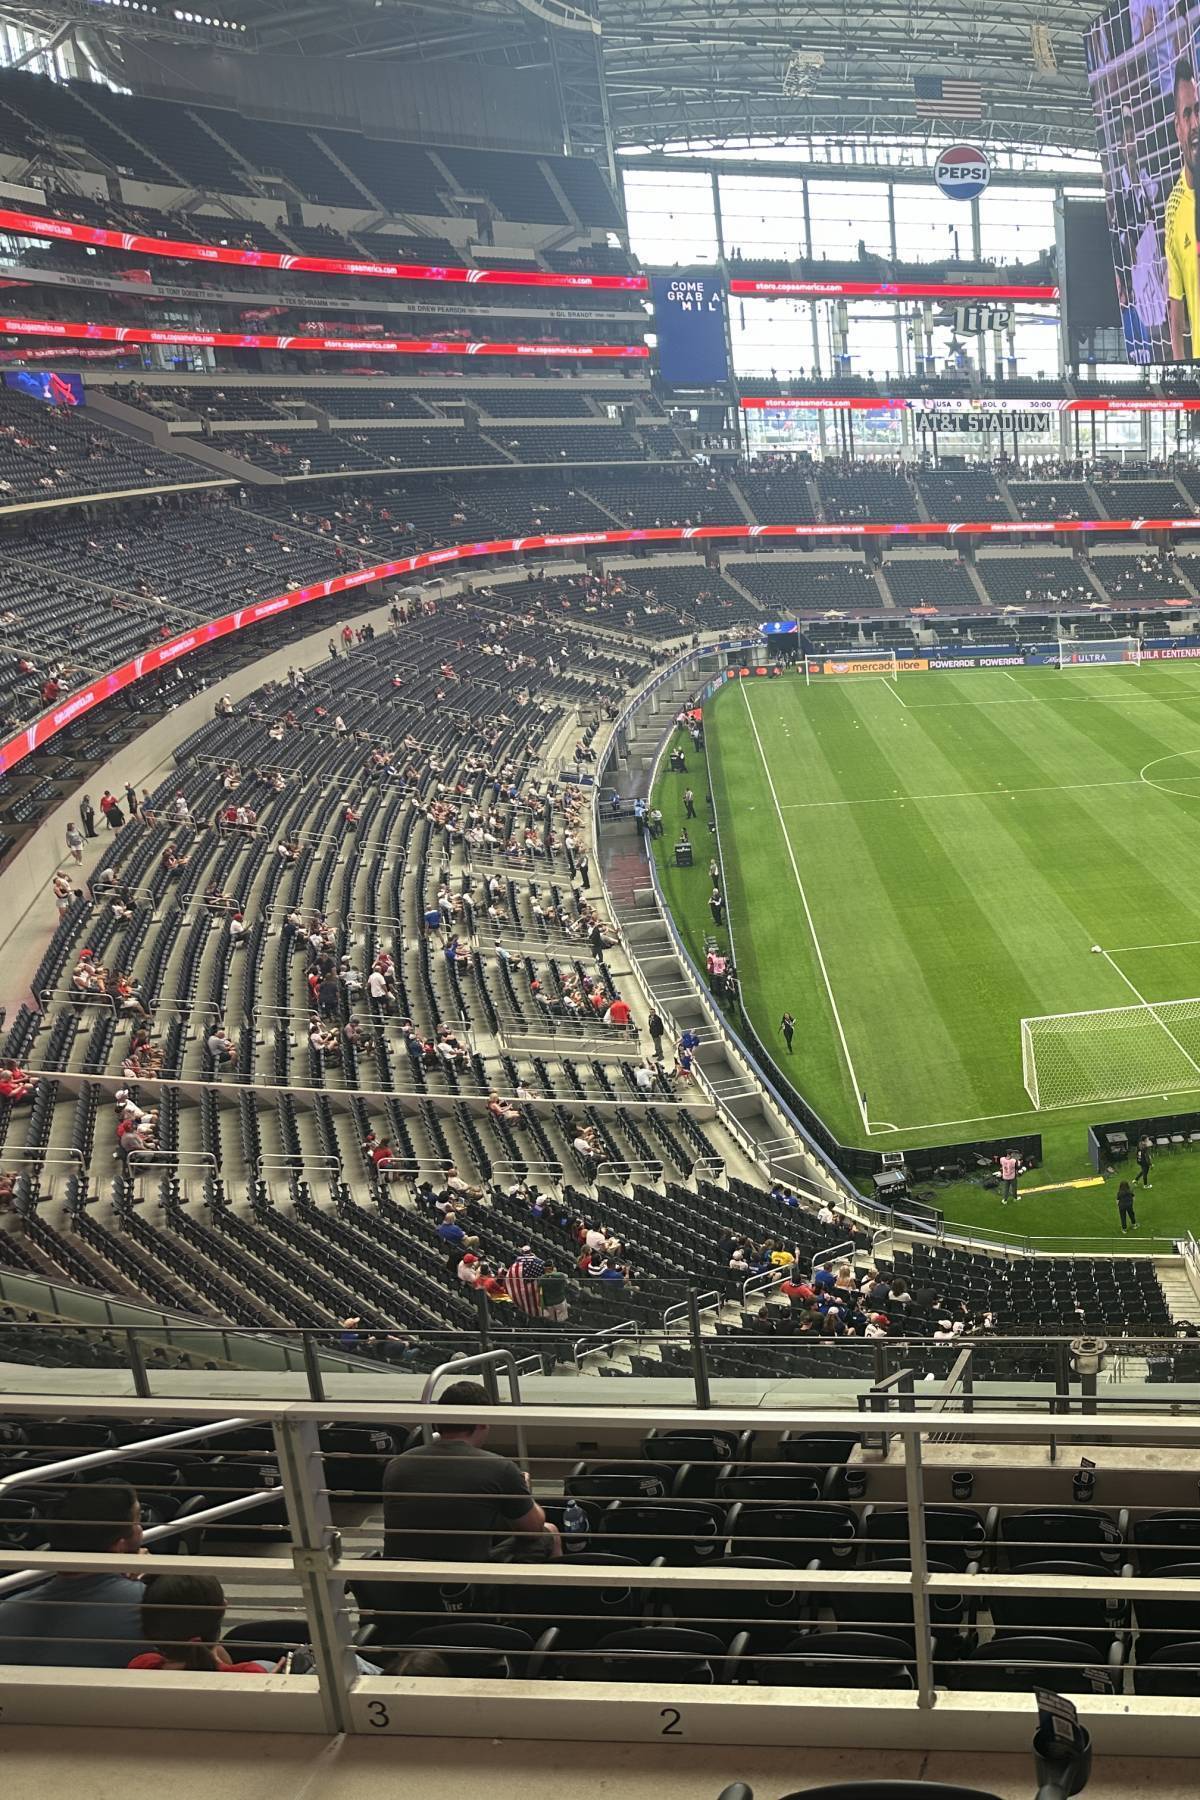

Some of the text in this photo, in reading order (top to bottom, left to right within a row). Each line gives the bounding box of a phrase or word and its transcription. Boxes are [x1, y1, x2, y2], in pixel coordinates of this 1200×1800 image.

[938, 167, 987, 180] PEPSI
[671, 282, 704, 292] COME
[756, 282, 842, 292] store.copaamerica.com
[667, 292, 720, 301] GRAB A
[418, 305, 436, 313] DREW
[437, 306, 466, 314] PEARSON
[953, 306, 1011, 337] Lite
[765, 399, 851, 408] store.copaamerica.com
[917, 413, 1049, 432] AT&T STADIUM
[1078, 653, 1107, 662] ULTRA
[1128, 650, 1160, 660] TEQUILA
[897, 660, 920, 670] libre
[929, 659, 975, 669] POWERADE
[979, 657, 1024, 667] POWERADE
[367, 1700, 390, 1728] 3
[660, 1708, 683, 1735] 2
